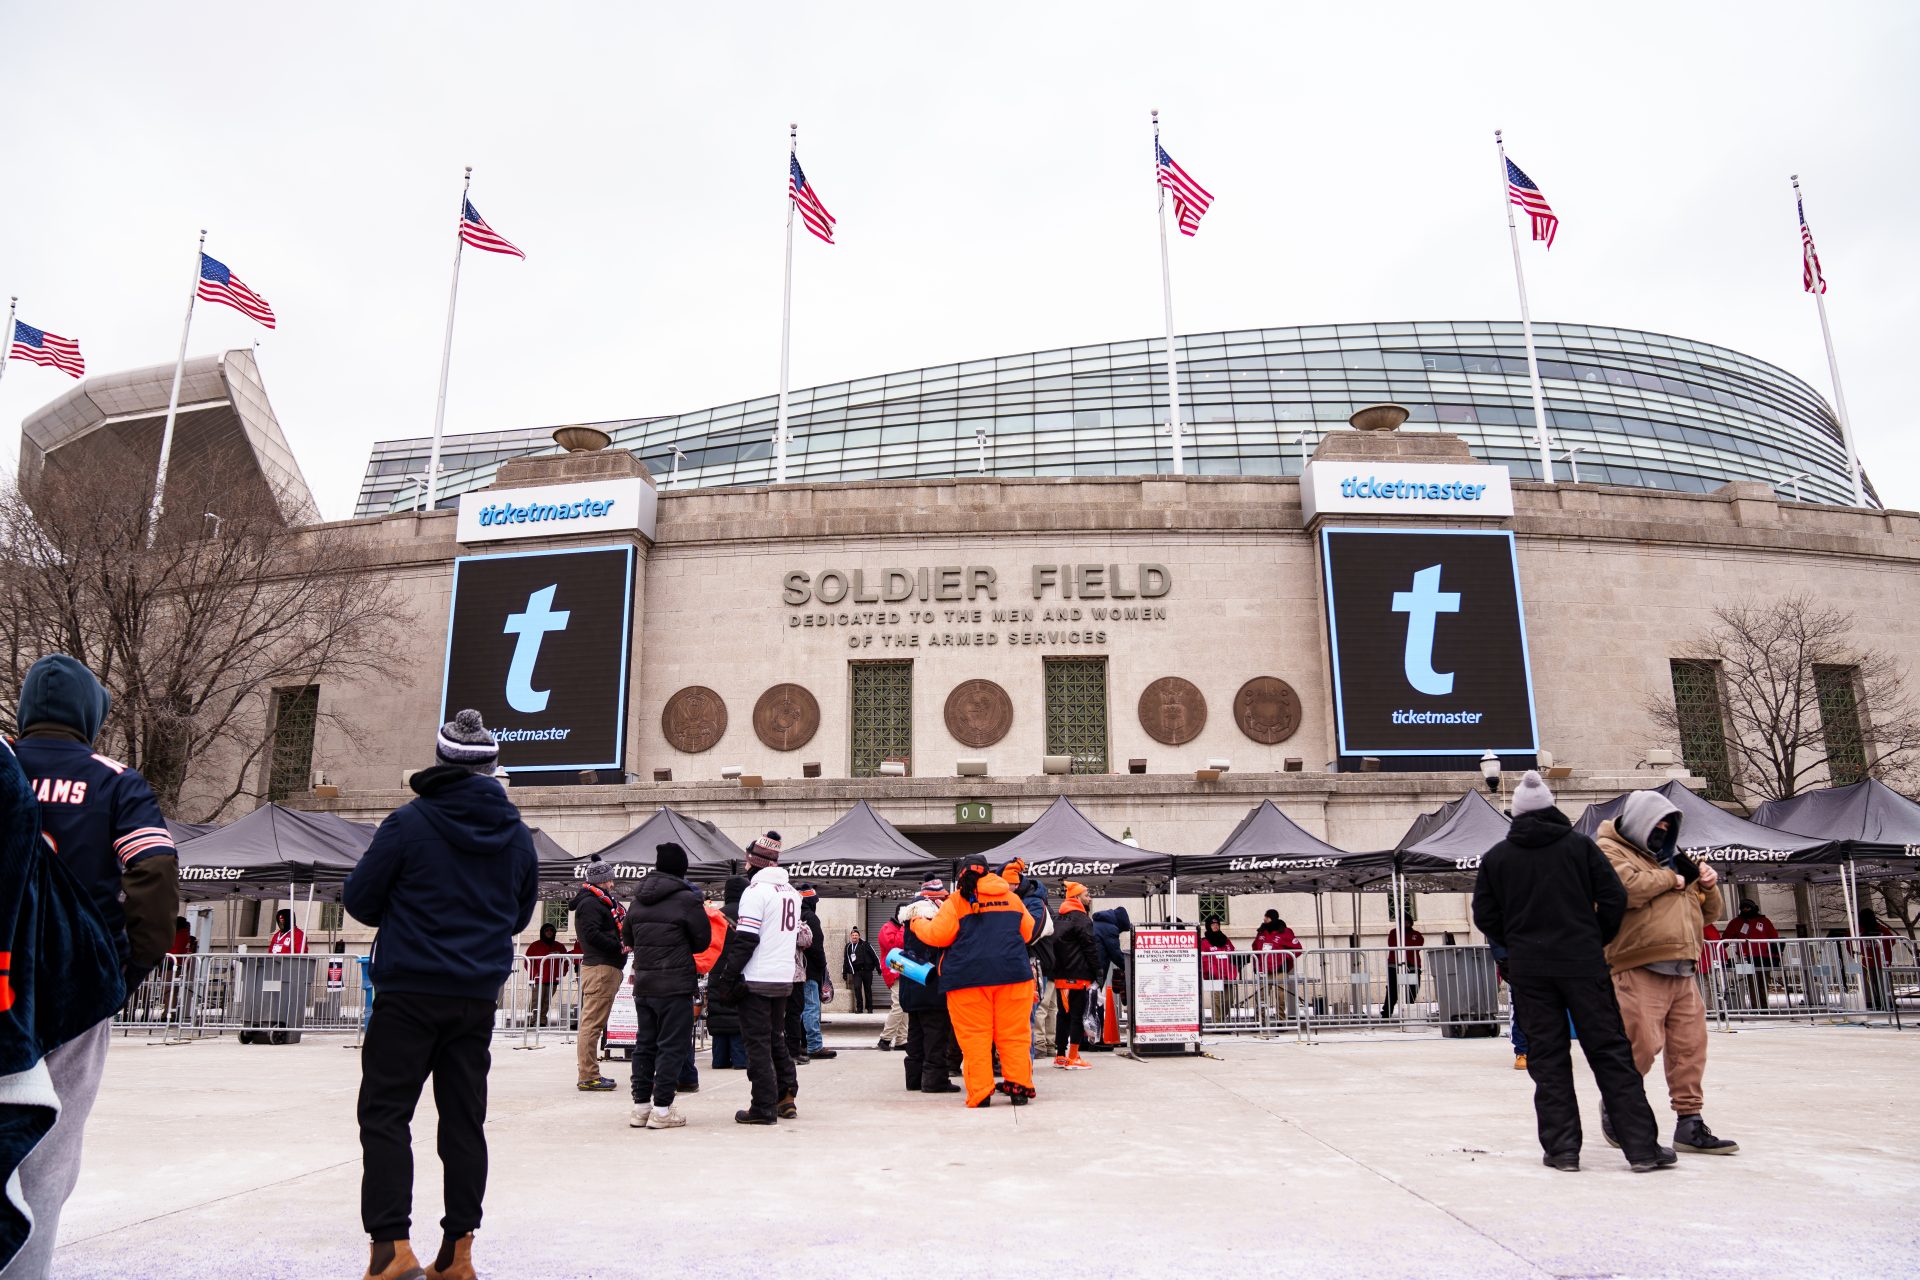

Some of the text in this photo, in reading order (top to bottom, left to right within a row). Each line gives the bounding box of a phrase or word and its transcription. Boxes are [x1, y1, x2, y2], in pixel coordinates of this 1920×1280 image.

[1340, 475, 1486, 501] ticketmaster
[478, 497, 615, 527] ticketmaster
[782, 562, 1172, 605] SOLDIER FIELD
[788, 606, 1167, 628] DEDICATED TO THE MEN AND WOMEN
[848, 630, 1108, 649] OF THE ARMED SERVICES
[1391, 563, 1461, 695] t
[503, 583, 570, 713] t
[1391, 709, 1482, 724] ticketmaster
[962, 806, 986, 819] 0 0
[788, 860, 900, 878] ticketmaster
[1229, 856, 1342, 871] ticketmaster
[781, 897, 795, 931] 18
[1136, 935, 1195, 944] ATTENTION
